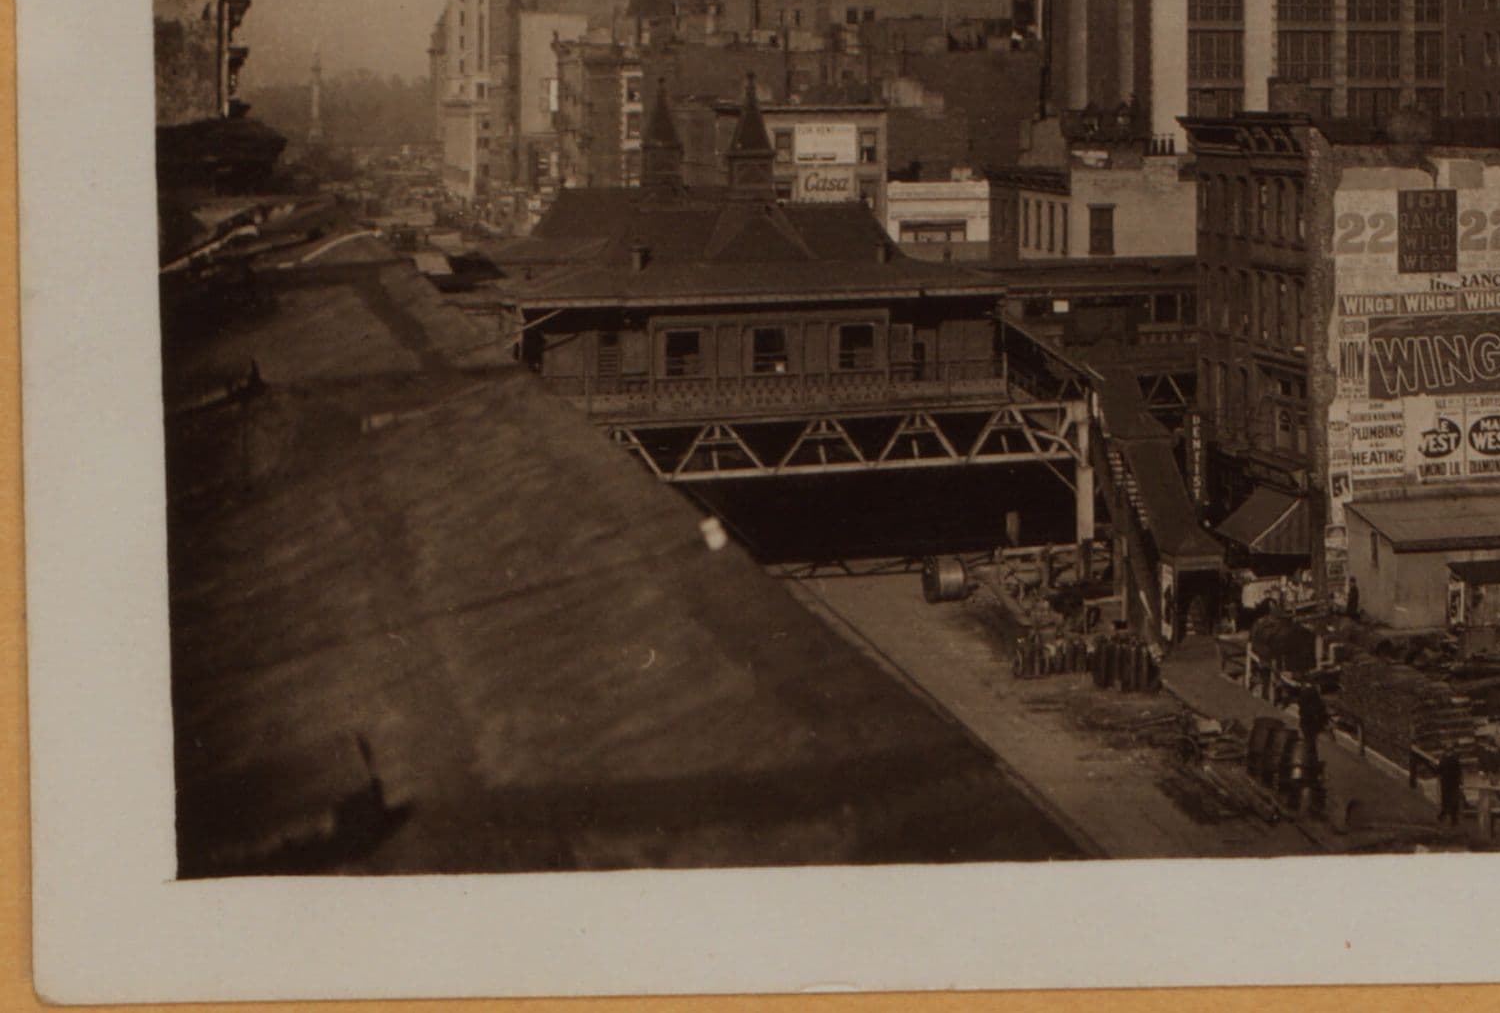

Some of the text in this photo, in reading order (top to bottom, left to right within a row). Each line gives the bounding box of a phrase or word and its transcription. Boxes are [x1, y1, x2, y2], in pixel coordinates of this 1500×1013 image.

[804, 172, 849, 193] Casa
[1406, 192, 1448, 209] 101
[1399, 212, 1455, 230] RANCH
[1336, 211, 1397, 254] 22
[1404, 233, 1451, 251] WILD
[1402, 254, 1453, 271] WEST
[1343, 294, 1395, 315] WINGS
[1403, 293, 1456, 312] WINGS
[1351, 423, 1404, 441] PLUMBING
[1191, 414, 1202, 500] DENTIST
[1351, 449, 1404, 467] HEATING
